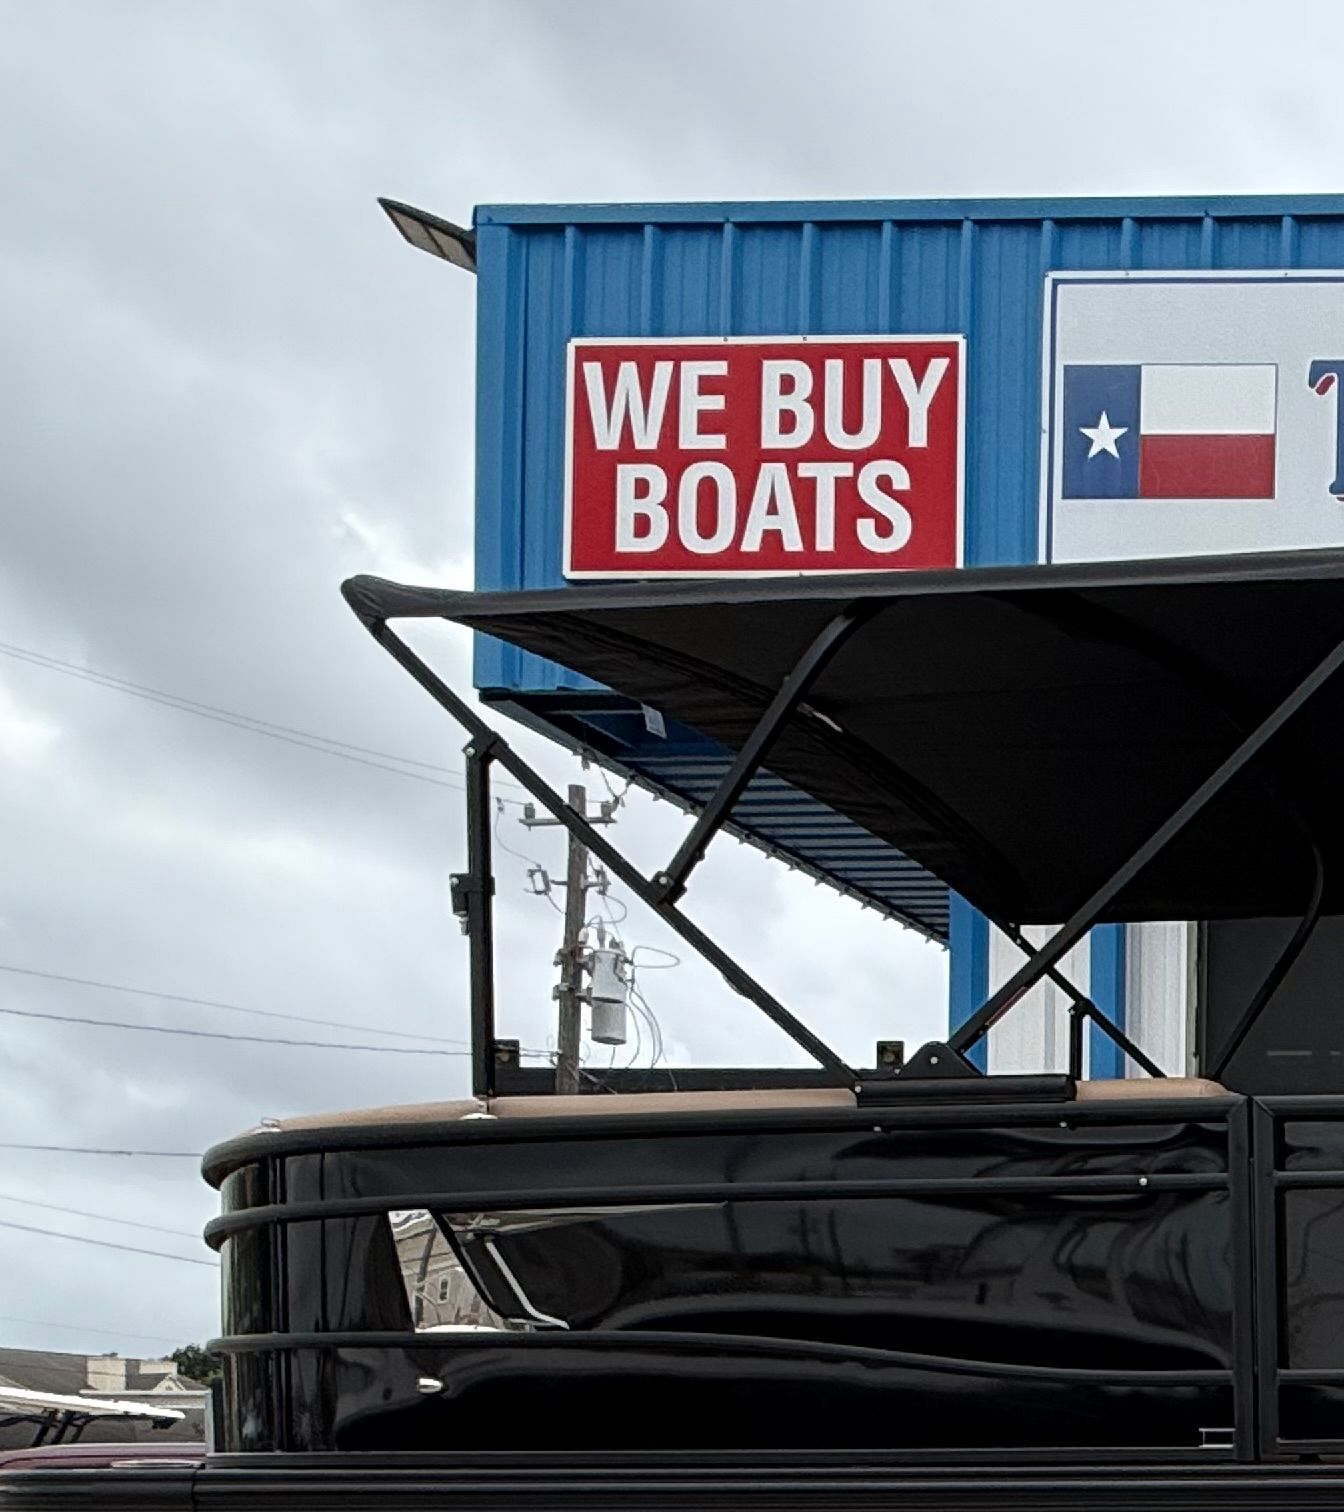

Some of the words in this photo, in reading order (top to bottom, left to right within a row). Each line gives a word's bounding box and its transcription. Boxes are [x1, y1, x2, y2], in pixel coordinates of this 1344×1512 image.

[583, 359, 727, 452] WE
[760, 356, 950, 452] BUY
[614, 459, 913, 555] BOATS
